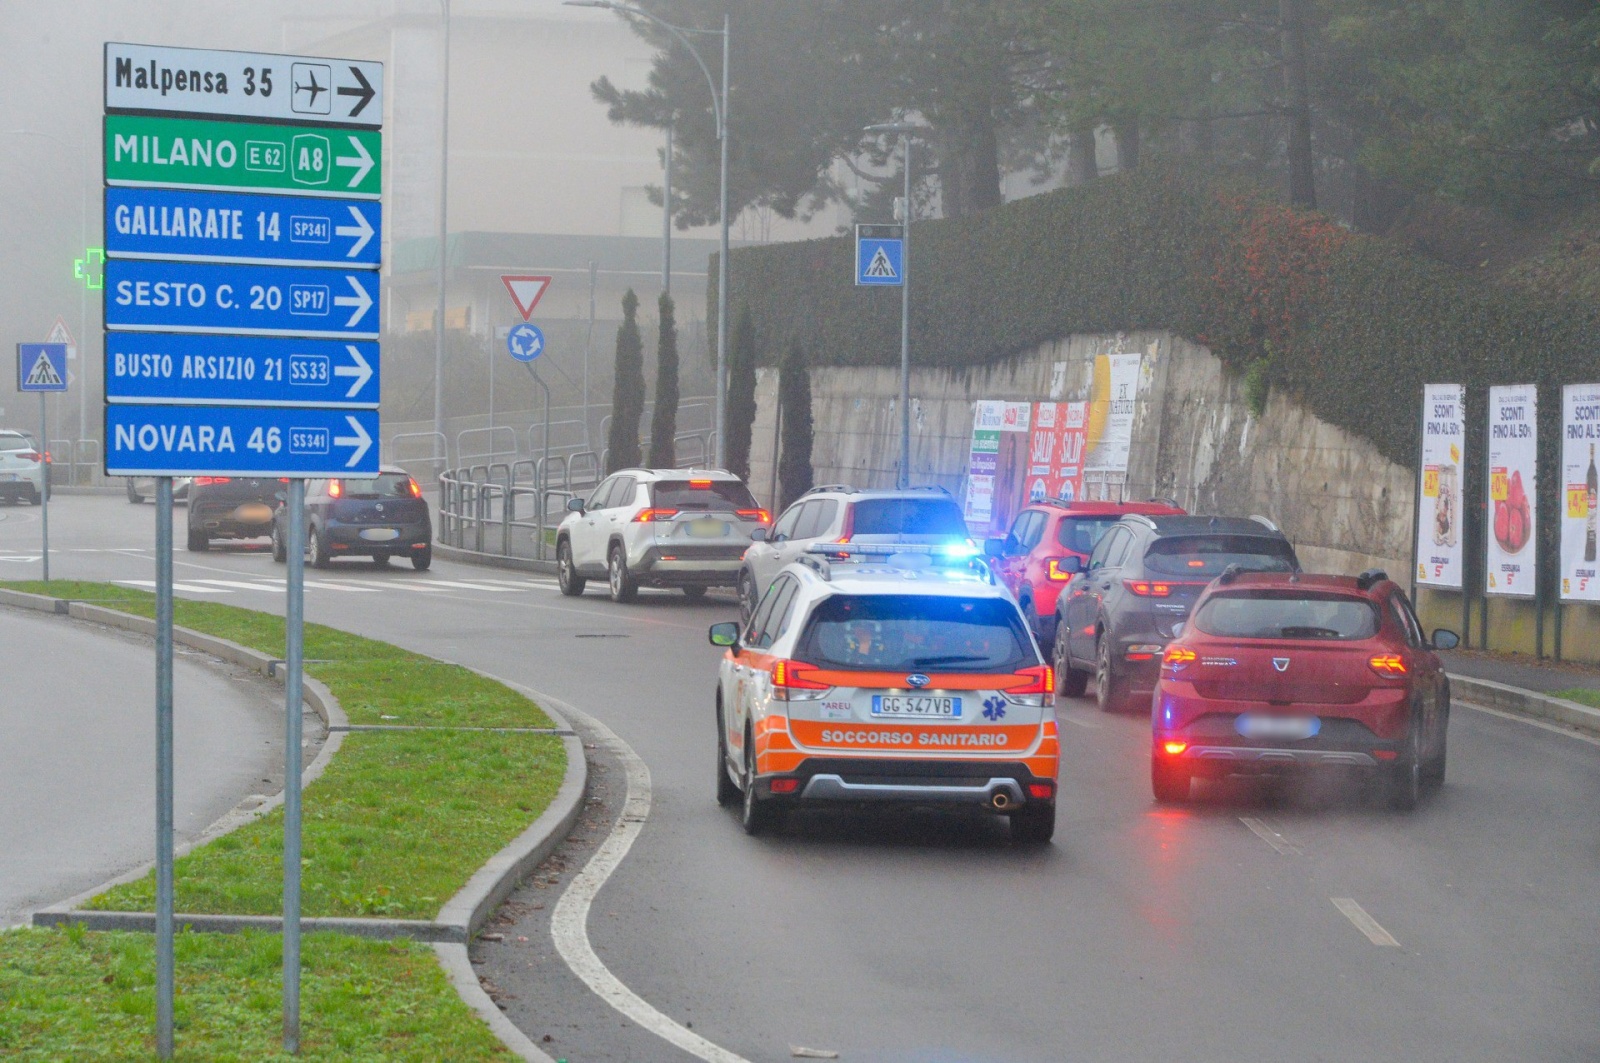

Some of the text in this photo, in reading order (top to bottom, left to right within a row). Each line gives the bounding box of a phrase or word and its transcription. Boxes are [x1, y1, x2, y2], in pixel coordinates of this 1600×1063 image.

[115, 57, 272, 97] Malpensa 35
[114, 134, 323, 172] MILANO E 62 A8
[115, 204, 326, 242] GALLARATE 14 SP341
[115, 280, 325, 311] SESTO C. 20 SP17
[115, 353, 327, 381] BUSTO ARSIZIO 21 SS33
[1434, 404, 1454, 418] SCONTI
[1501, 406, 1524, 421] SCONTI
[1575, 405, 1600, 421] SCONT
[1427, 422, 1441, 435] FINO
[1442, 422, 1449, 435] AL
[1493, 423, 1532, 438] FINO AL 50%
[1567, 424, 1583, 439] FINO
[1586, 424, 1595, 438] AL
[115, 423, 325, 453] NOVARA 46 SS341
[1032, 431, 1055, 463] SALDI
[1061, 431, 1083, 464] SALDI
[825, 702, 851, 710] AREU
[882, 698, 952, 714] GG 547VB
[822, 730, 1008, 746] SOCCORSO SANITARIO
